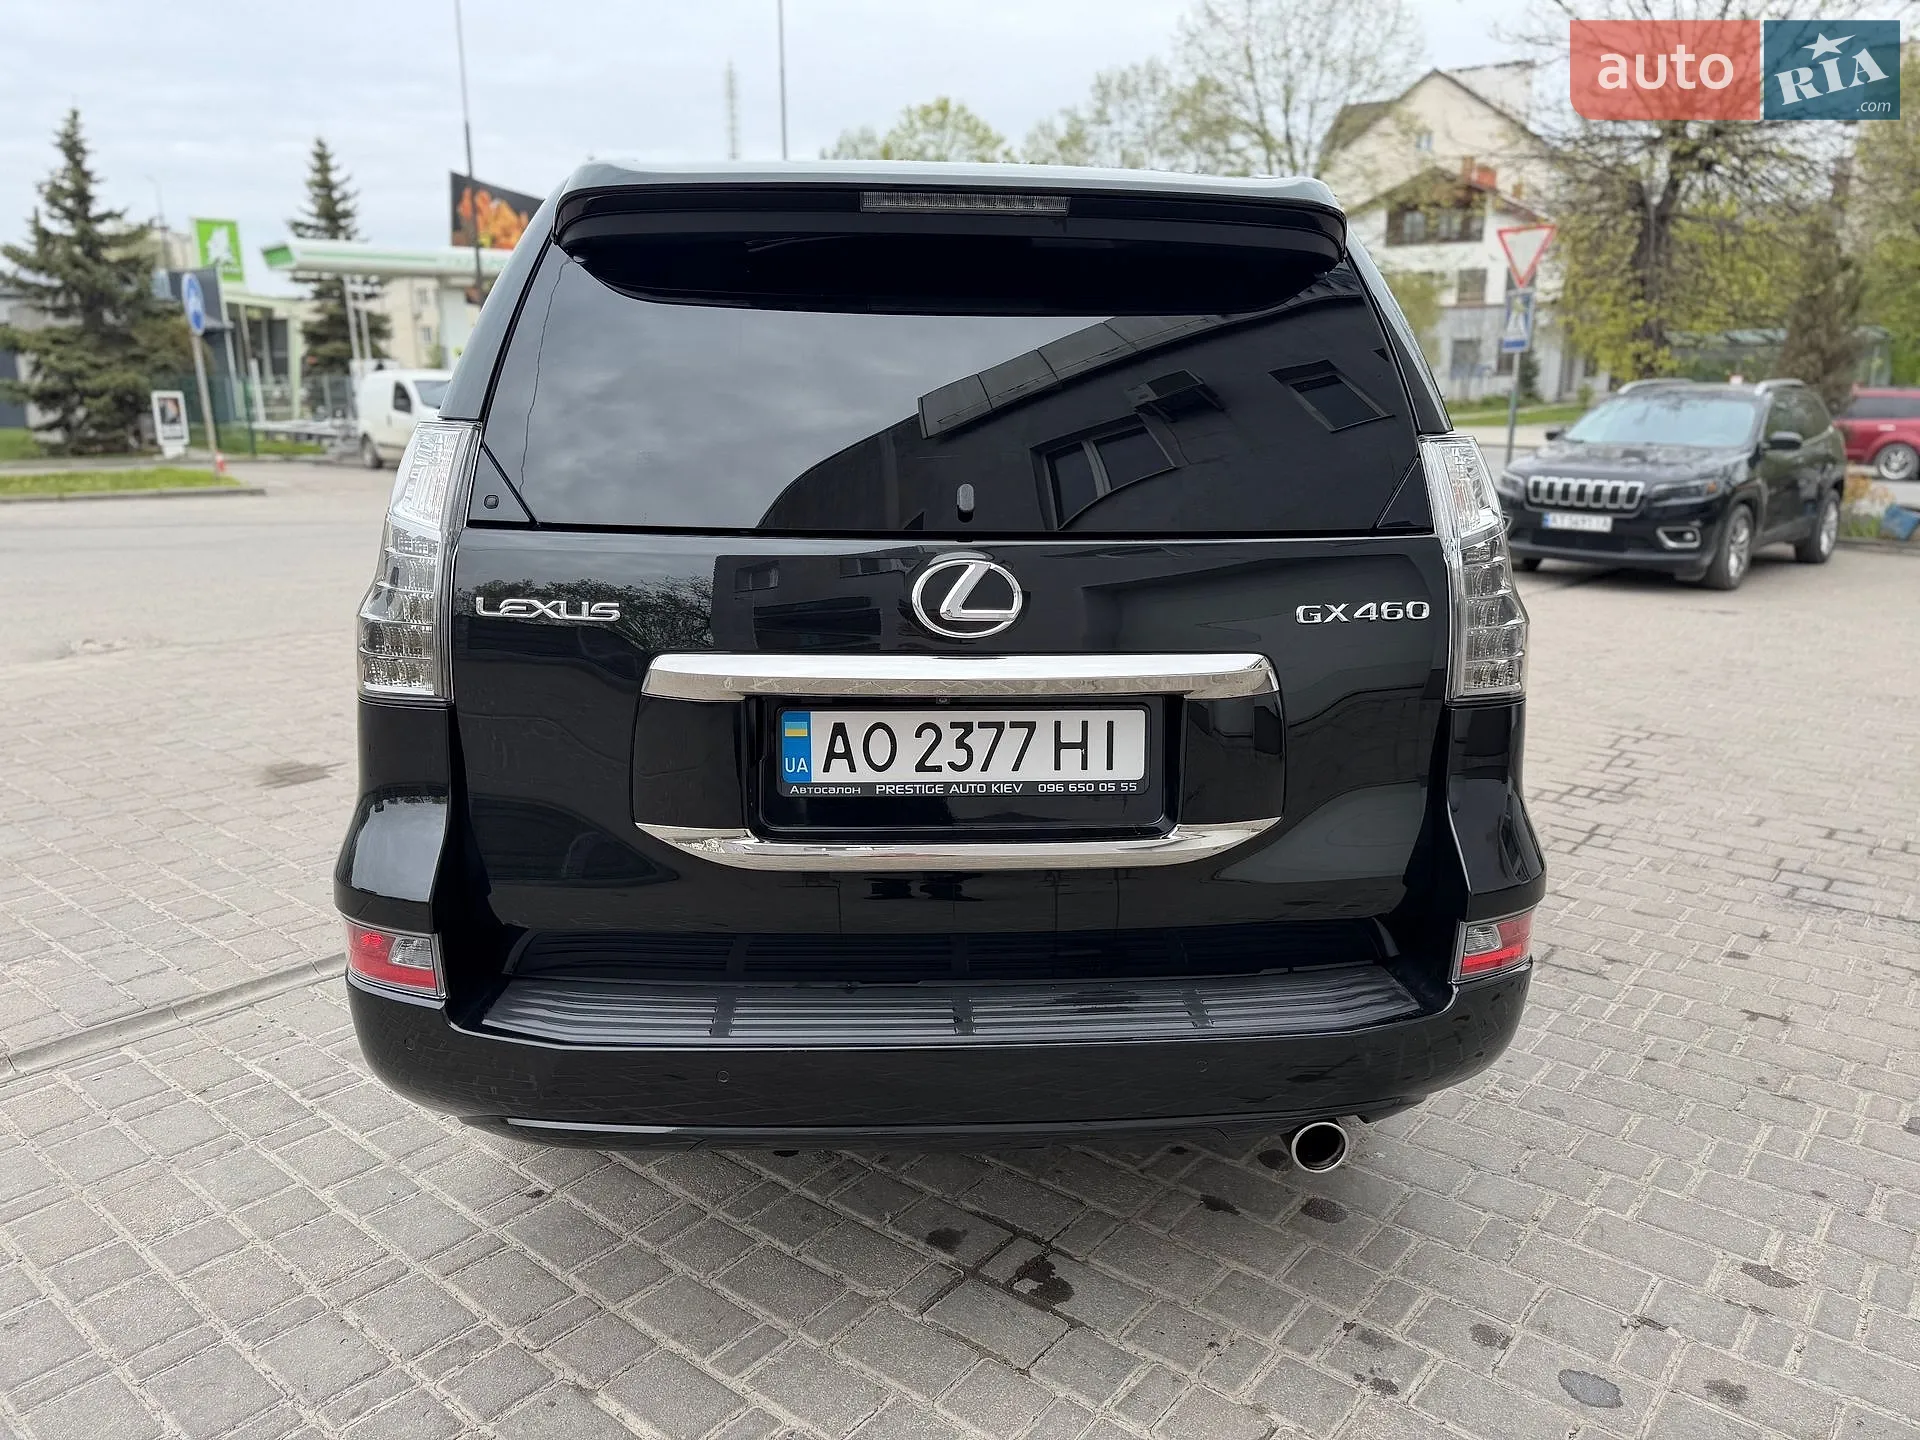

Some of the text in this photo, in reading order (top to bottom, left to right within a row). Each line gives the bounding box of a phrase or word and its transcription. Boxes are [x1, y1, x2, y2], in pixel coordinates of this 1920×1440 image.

[475, 597, 621, 622] LEXUS
[822, 720, 1114, 773] AO 2377 HI
[785, 758, 808, 773] UA
[789, 785, 861, 795] Автосалон
[876, 784, 1023, 795] PRESTIGE AUTO KIEV
[1038, 782, 1137, 793] 096 650 05 55
